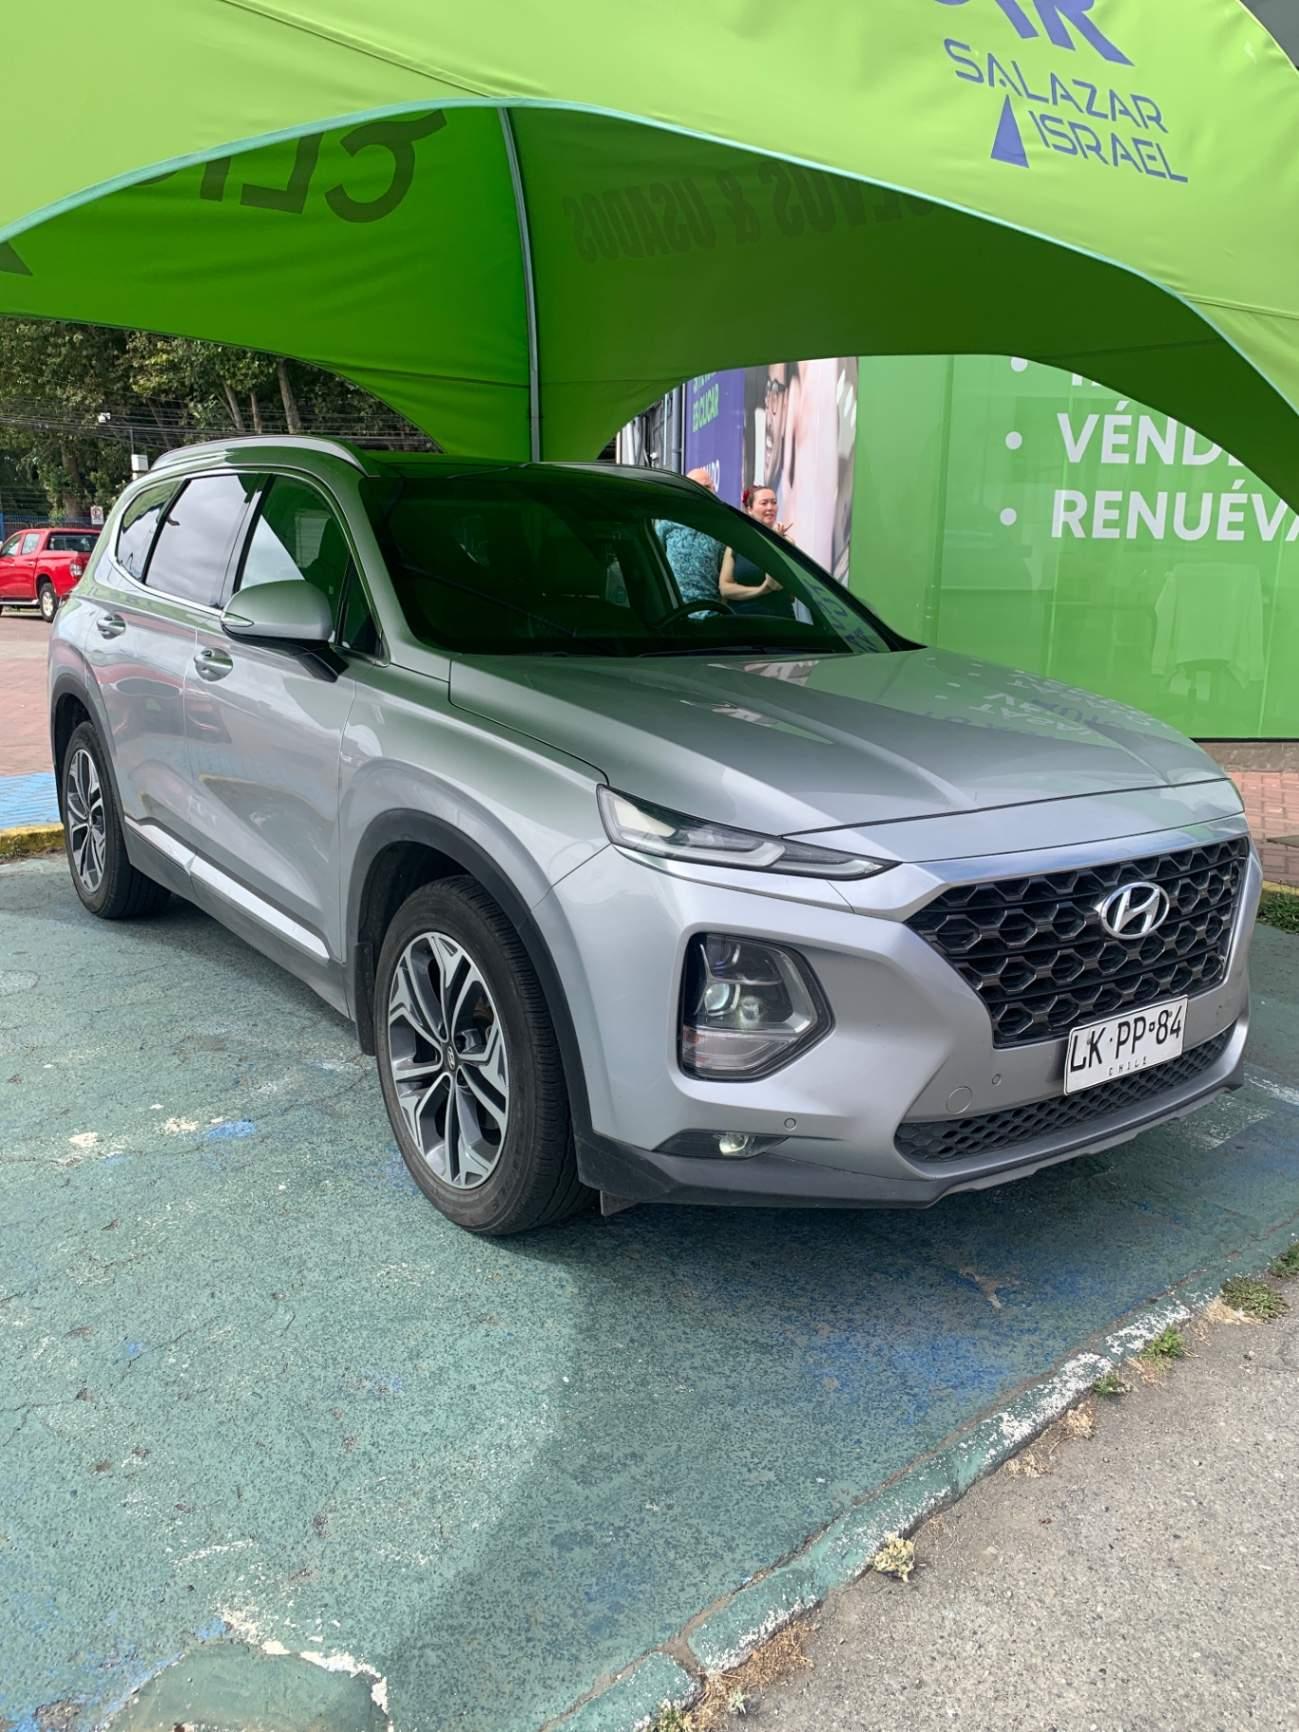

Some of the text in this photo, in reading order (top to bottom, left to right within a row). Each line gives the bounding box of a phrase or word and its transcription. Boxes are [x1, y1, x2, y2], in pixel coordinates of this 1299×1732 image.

[943, 38, 1169, 134] SALAZAR
[1028, 110, 1189, 184] ISRAEL
[1057, 400, 1246, 466] VÉND
[1108, 1056, 1147, 1076] CHILE
